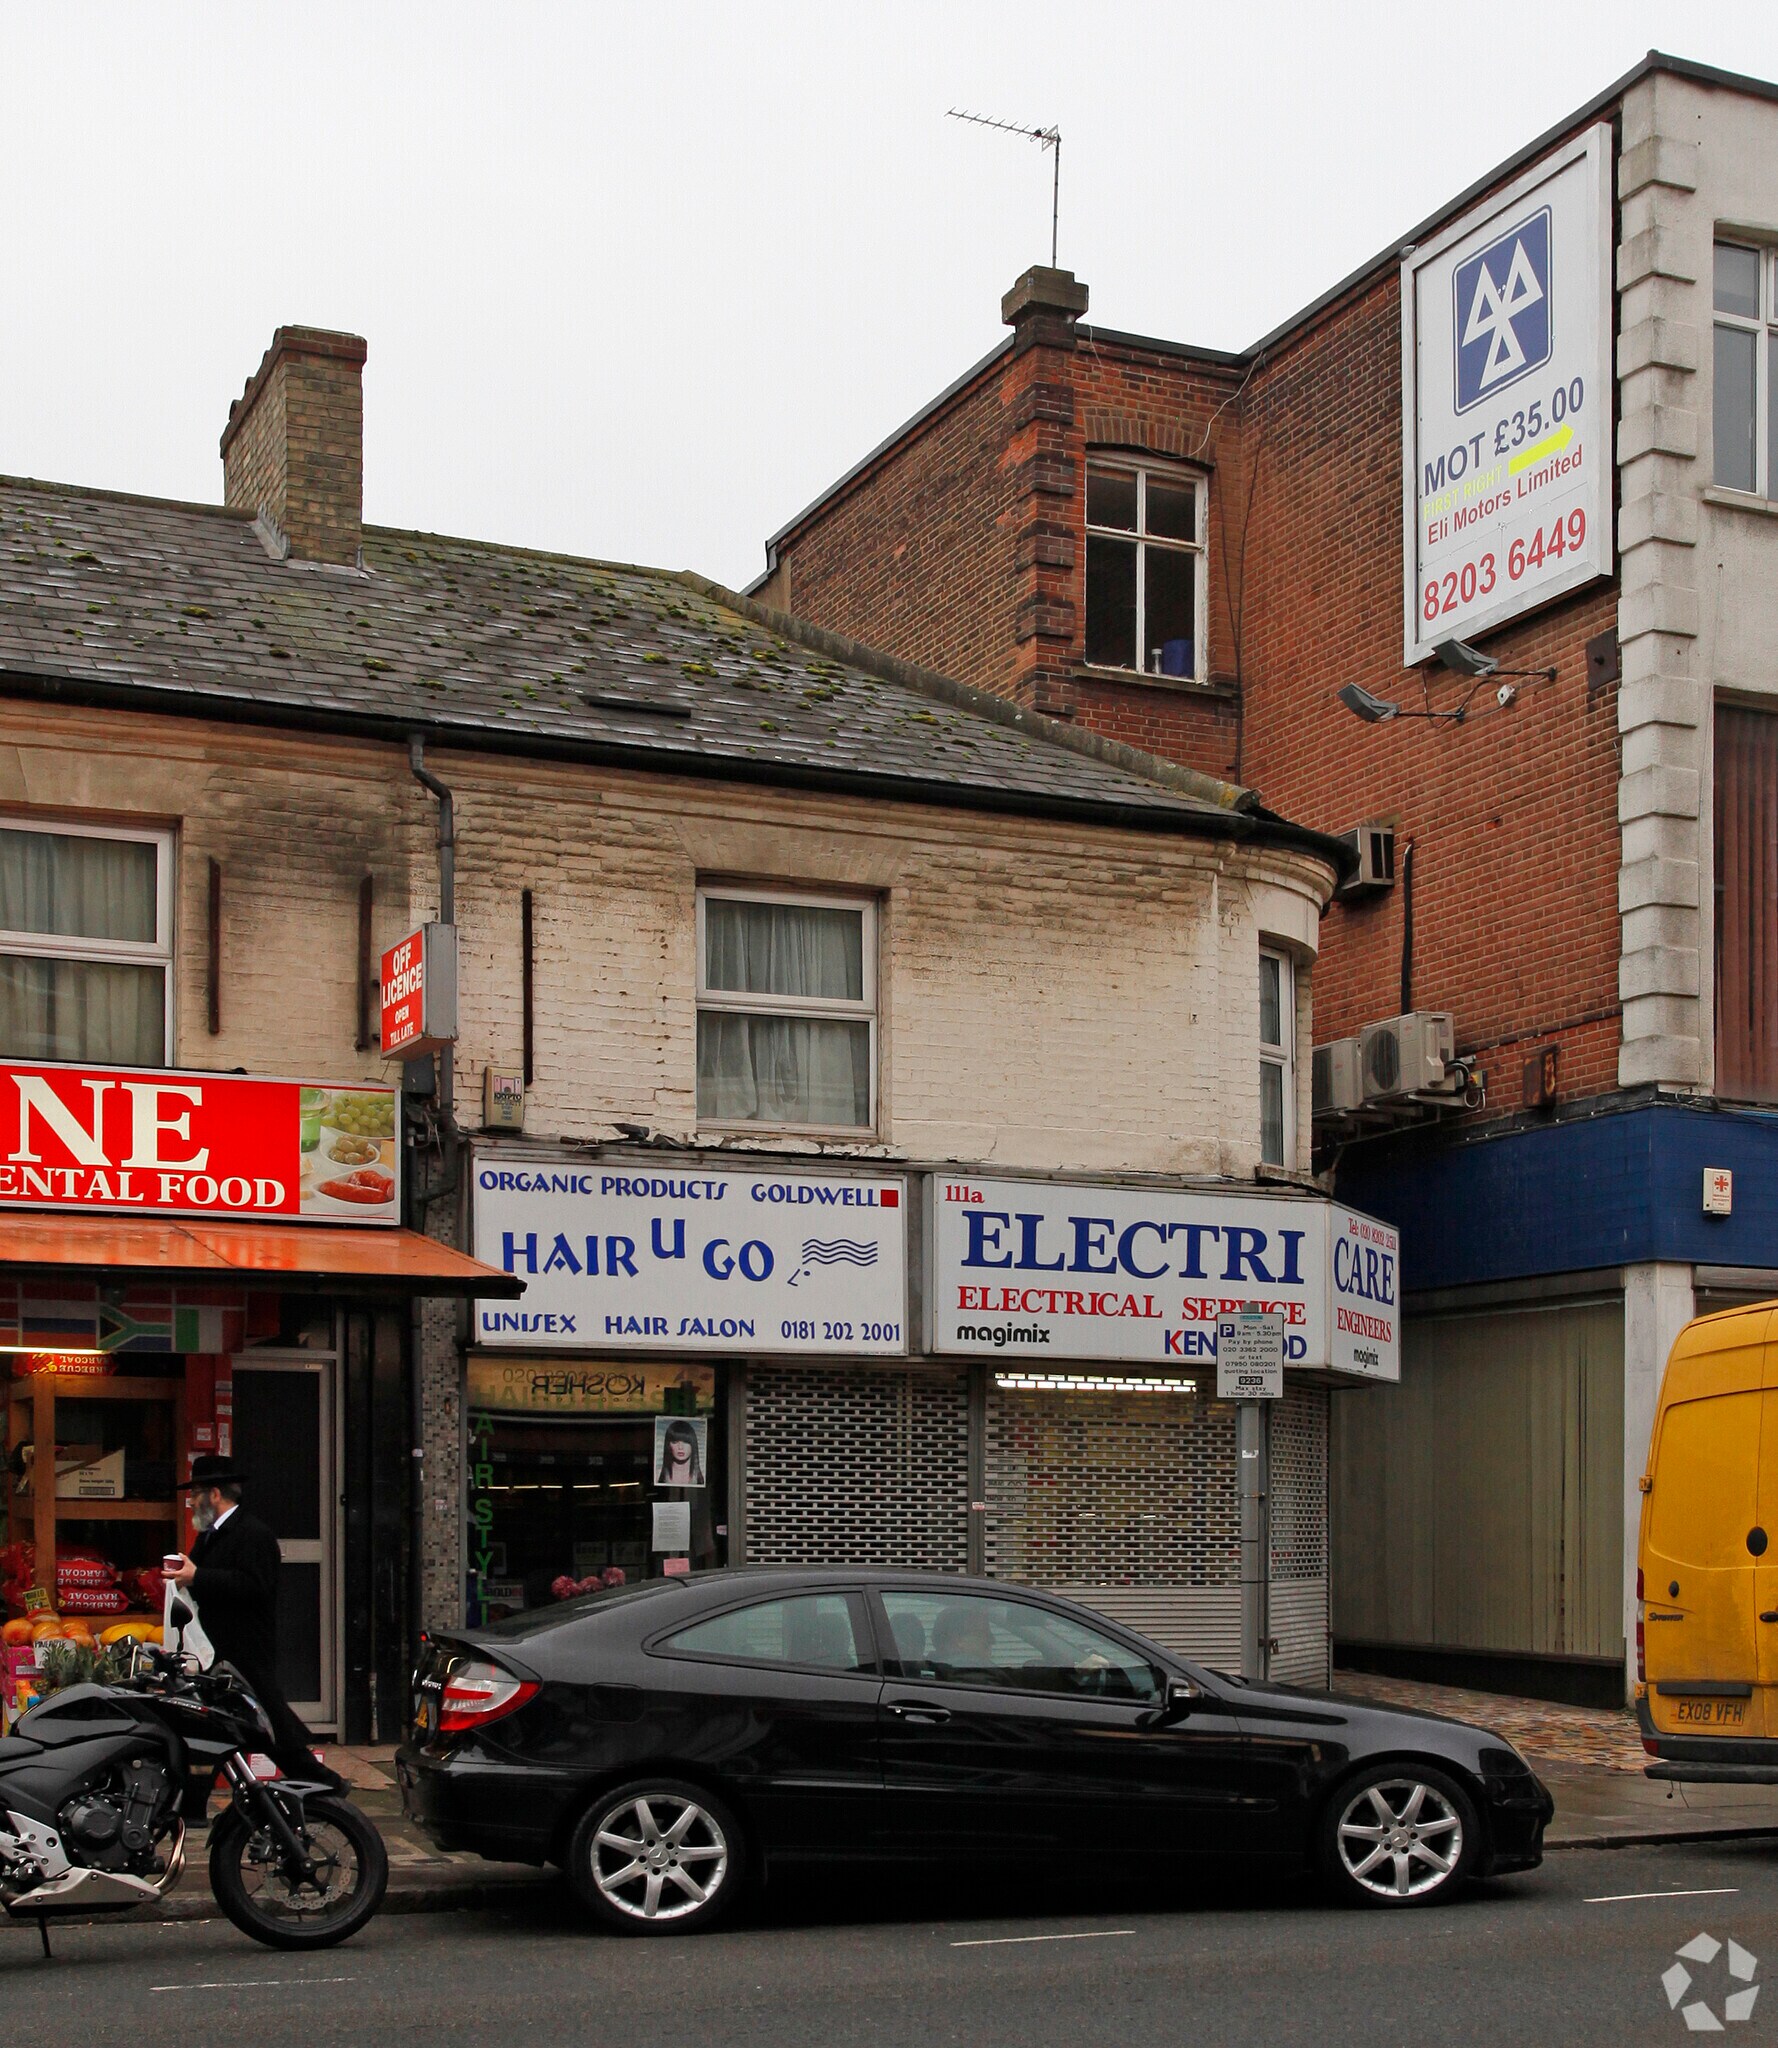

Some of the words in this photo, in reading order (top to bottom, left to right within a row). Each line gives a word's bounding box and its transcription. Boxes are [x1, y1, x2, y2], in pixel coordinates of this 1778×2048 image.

[1424, 431, 1486, 496] MOT
[1494, 376, 1584, 457] £35.00
[1423, 488, 1460, 522] FIRST
[1463, 464, 1503, 500] RIGHT
[1428, 516, 1449, 545] Eli
[1453, 489, 1511, 530] Motors
[1517, 443, 1583, 499] Limited
[1423, 553, 1497, 621] 8203
[1508, 507, 1586, 581] 6449
[392, 941, 412, 976] OFF
[382, 962, 423, 1010] LICENCE
[390, 1029, 401, 1046] TILL
[401, 1021, 414, 1041] LATE
[394, 1004, 410, 1025] OPEN
[7, 1073, 210, 1172] NE
[0, 1165, 144, 1202] ENTAL
[157, 1173, 286, 1208] FOOD
[479, 1170, 593, 1195] ORGANIC
[601, 1176, 729, 1201] PRODUCTS
[751, 1183, 880, 1207] GOLDWELL
[502, 1231, 640, 1278] HAIR
[702, 1238, 775, 1282] GO
[960, 1210, 1306, 1285] ELECTRI
[1333, 1236, 1395, 1306] CARE
[956, 1285, 1163, 1320] ELECTRICAL
[482, 1312, 577, 1334] UNISEX
[605, 1315, 669, 1337] HAIR
[676, 1316, 756, 1338] SALON
[781, 1322, 816, 1341] 0181
[824, 1323, 855, 1341] 202
[861, 1323, 900, 1342] 2001
[957, 1322, 1050, 1347] magimix
[1164, 1328, 1308, 1360] KEND
[1336, 1306, 1392, 1343] ENGINEERS
[1677, 1702, 1711, 1721] EX08
[1716, 1703, 1744, 1723] VFH
